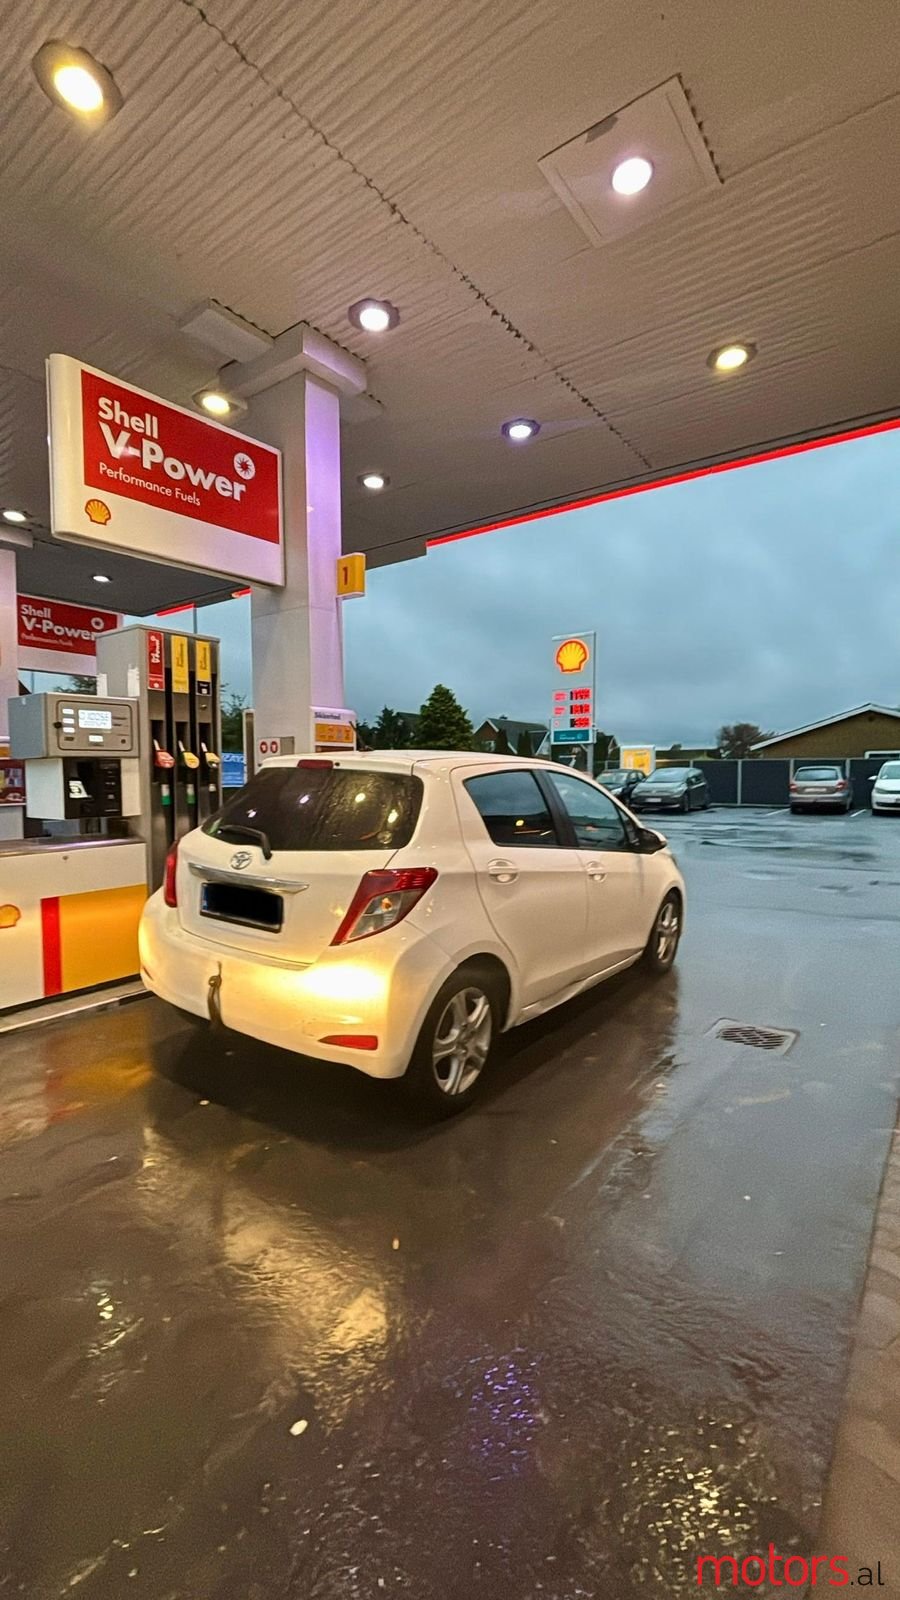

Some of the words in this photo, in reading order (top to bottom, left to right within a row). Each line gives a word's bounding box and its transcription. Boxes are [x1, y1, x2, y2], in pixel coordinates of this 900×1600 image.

[98, 396, 159, 440] Shell
[98, 421, 248, 503] V-Power
[98, 461, 173, 498] Performance
[174, 487, 202, 507] Fuels
[342, 565, 350, 586] 1
[20, 603, 52, 620] Shell
[21, 615, 96, 641] V-Power
